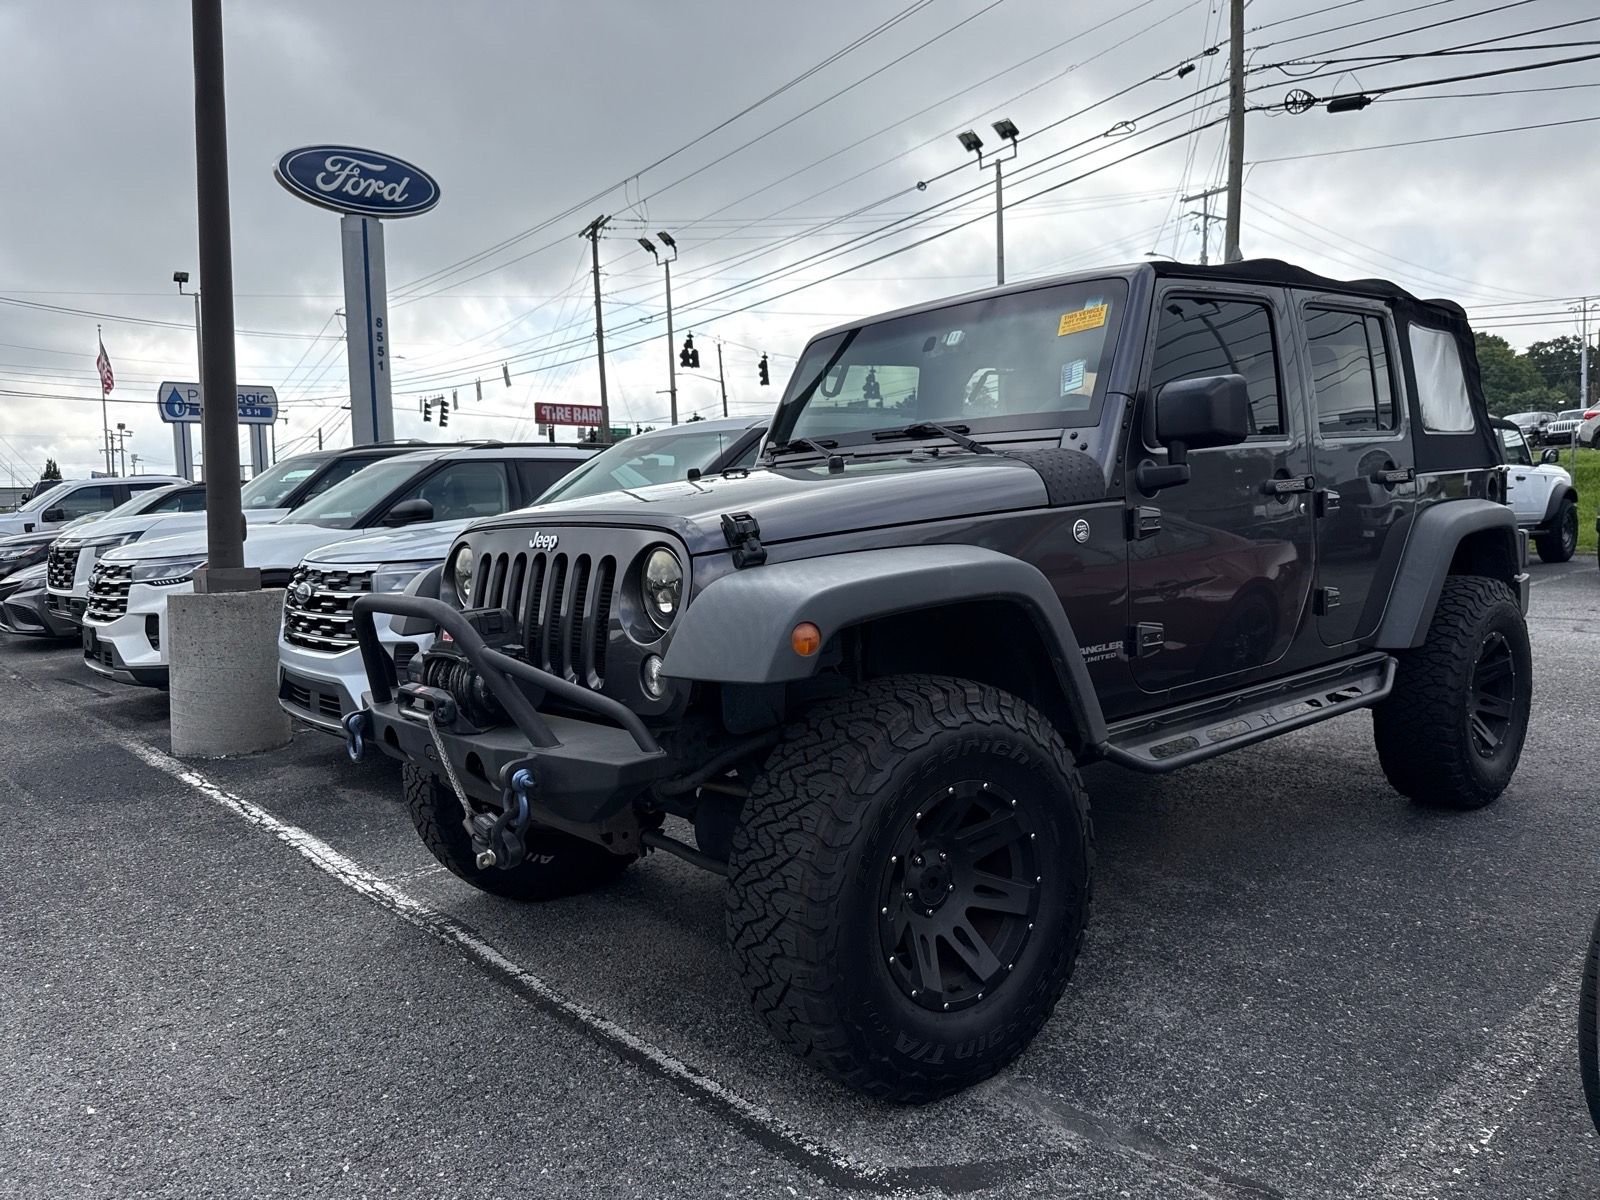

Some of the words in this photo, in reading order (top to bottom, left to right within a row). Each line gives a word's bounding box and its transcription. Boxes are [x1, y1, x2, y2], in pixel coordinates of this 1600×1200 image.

[316, 155, 410, 202] Ford
[375, 317, 385, 372] 8551
[238, 392, 268, 406] agic
[541, 405, 572, 422] TIRE
[529, 531, 558, 552] Jeep
[1080, 640, 1124, 655] ANGLER
[1084, 652, 1117, 663] LIMITED
